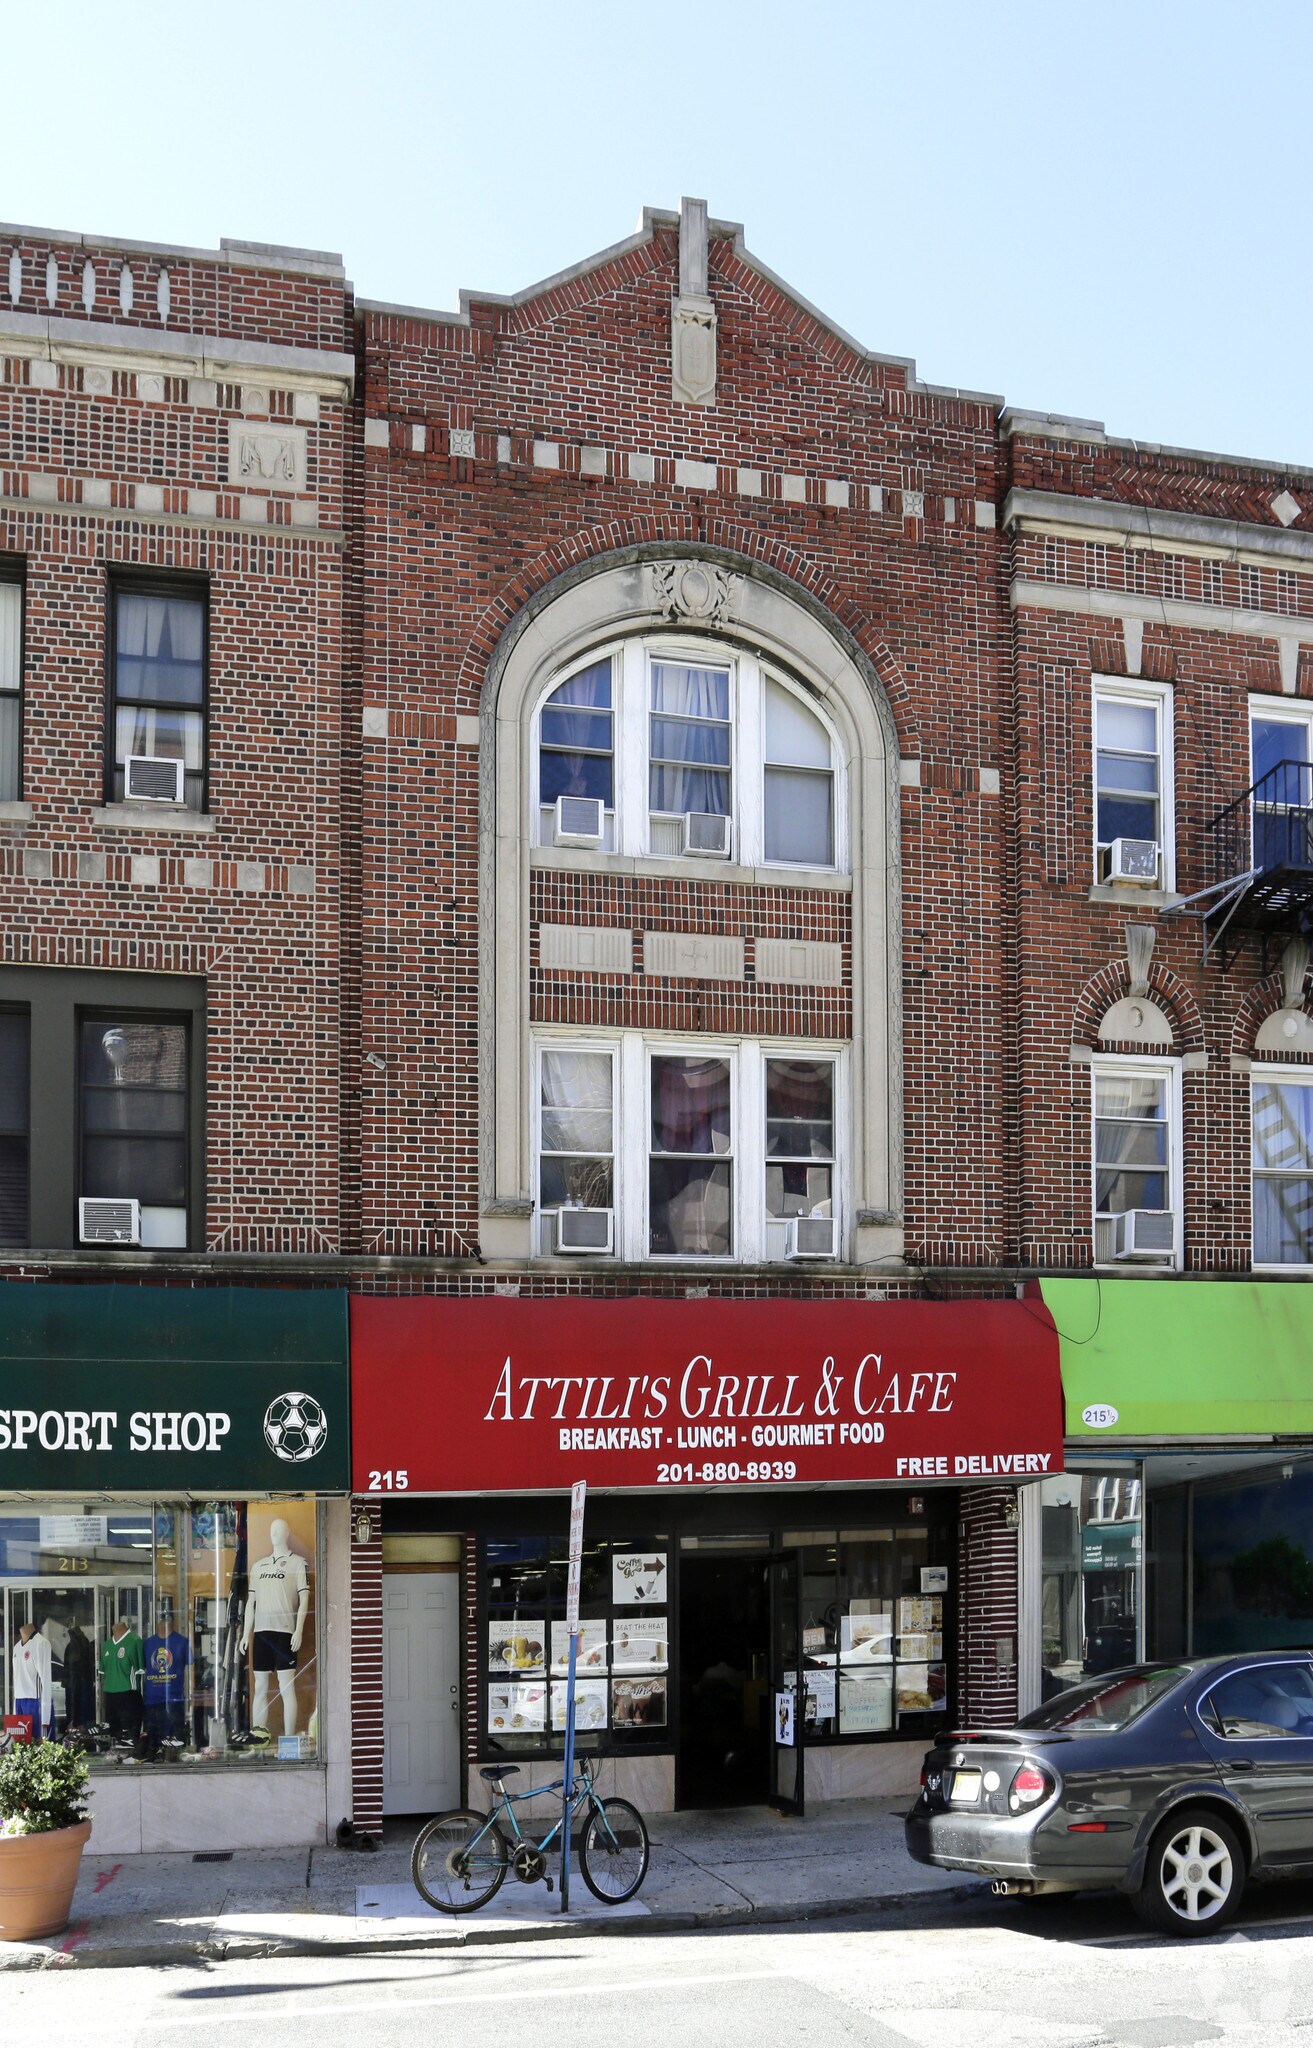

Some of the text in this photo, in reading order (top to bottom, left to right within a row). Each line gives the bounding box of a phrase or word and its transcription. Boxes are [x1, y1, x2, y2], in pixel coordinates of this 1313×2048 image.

[483, 1353, 957, 1421] ATTILI'S GRILL & CAFE
[0, 1410, 231, 1452] SPORT SHOP
[559, 1426, 664, 1451] BREAKFAST
[677, 1425, 737, 1449] LUNCH
[751, 1423, 836, 1447] GOURMET
[839, 1422, 885, 1445] FOOD
[656, 1461, 797, 1483] 201-880-8939
[896, 1453, 1052, 1477] FREE DELIVERY
[368, 1470, 409, 1491] 215
[58, 1557, 88, 1571] 213
[648, 1622, 665, 1630] HEAT
